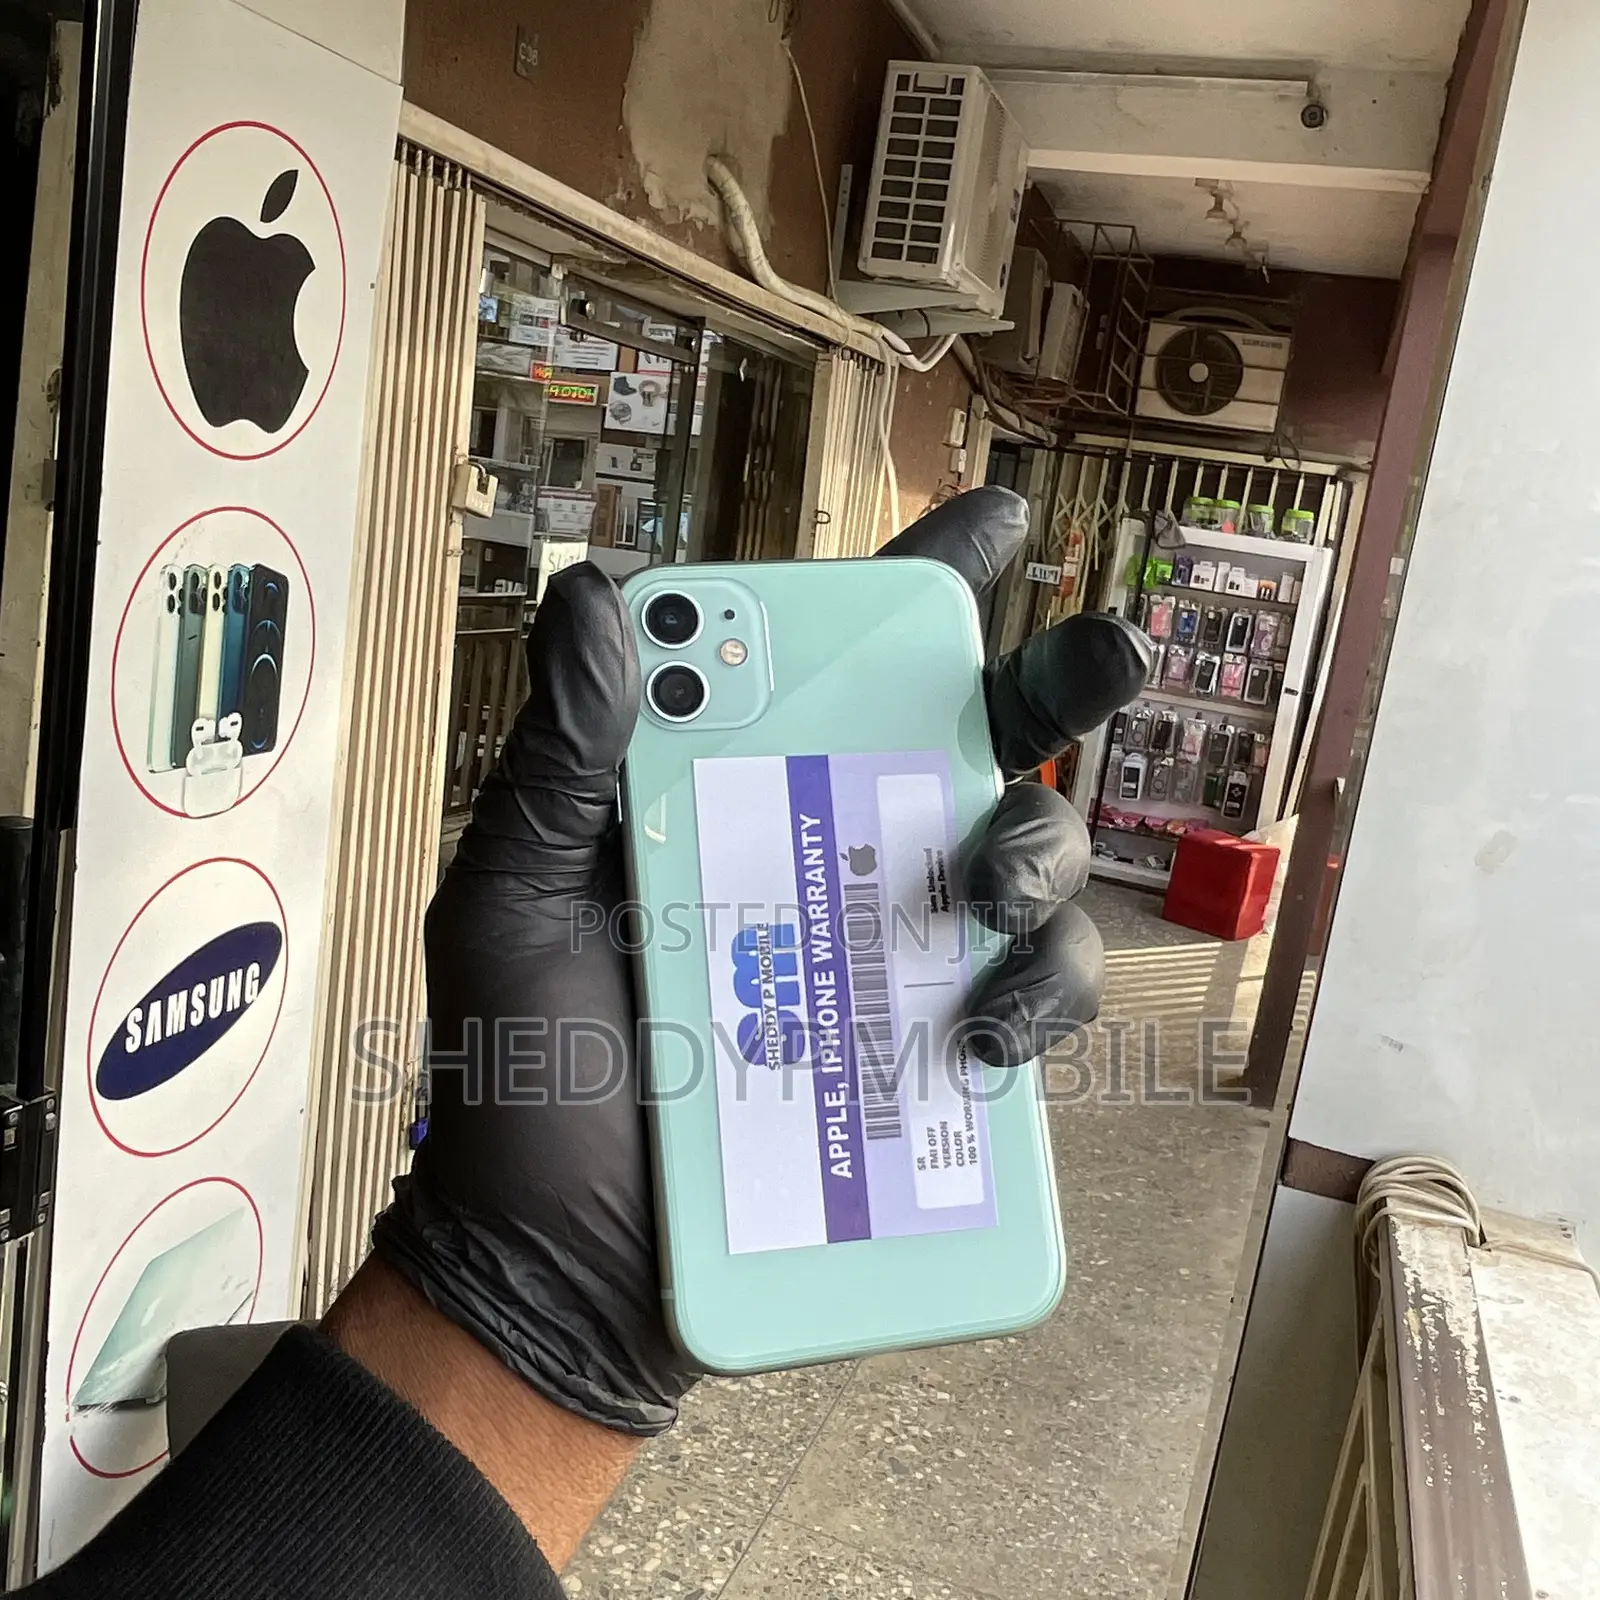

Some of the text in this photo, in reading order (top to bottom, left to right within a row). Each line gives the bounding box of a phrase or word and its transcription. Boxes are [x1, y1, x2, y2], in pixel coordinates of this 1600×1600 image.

[938, 883, 951, 913] Apple
[124, 961, 261, 1054] SAMSUNG
[756, 922, 781, 1071] SHEDDY P MOBILE
[799, 813, 853, 1179] APPLE, IPHONE WARRANTY
[960, 1078, 974, 1133] WORKING
[926, 1126, 940, 1170] FMI OFF
[939, 1120, 952, 1169] VERSION
[953, 1130, 965, 1168] COLOR
[966, 1133, 976, 1145] %
[968, 1146, 978, 1166] 100
